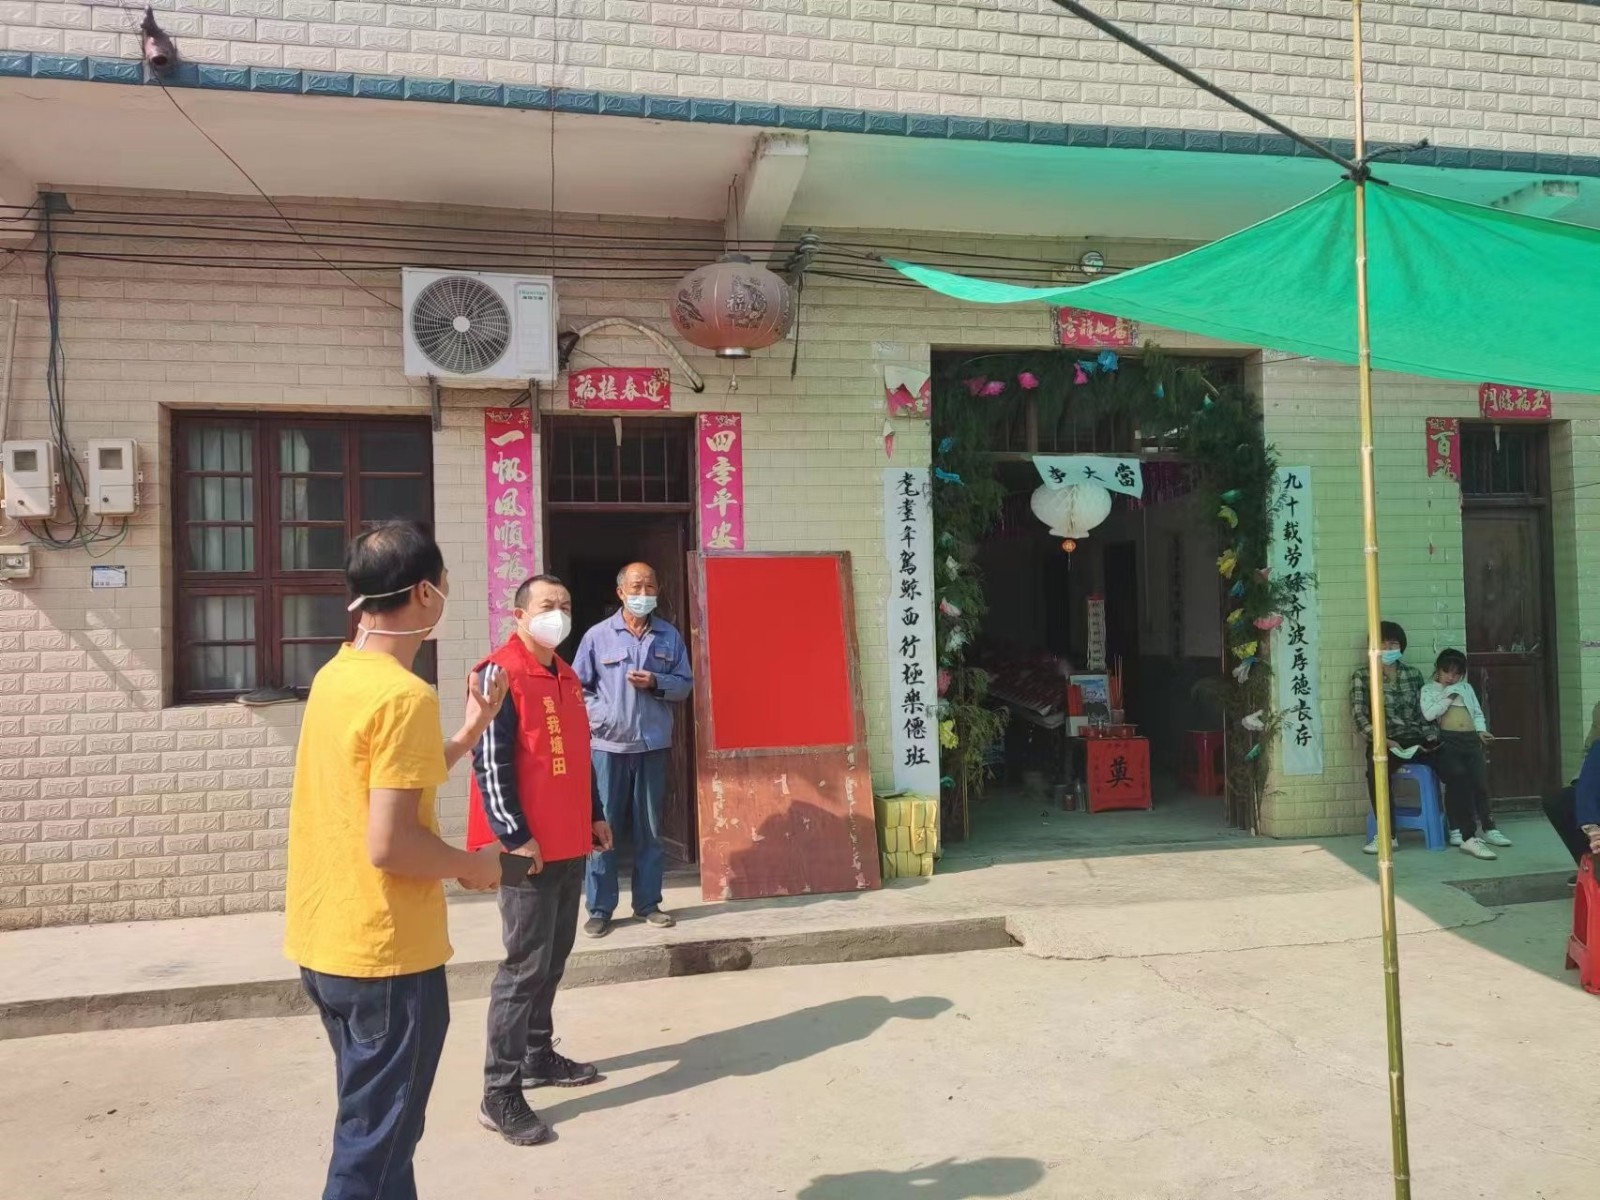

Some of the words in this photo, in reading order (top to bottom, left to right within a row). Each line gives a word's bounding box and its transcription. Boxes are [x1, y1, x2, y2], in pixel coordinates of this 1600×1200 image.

[574, 374, 664, 402] 迎春接福
[705, 430, 738, 549] 四季平安
[542, 696, 567, 776] 爱我塘田
[1105, 755, 1133, 788] 奠
